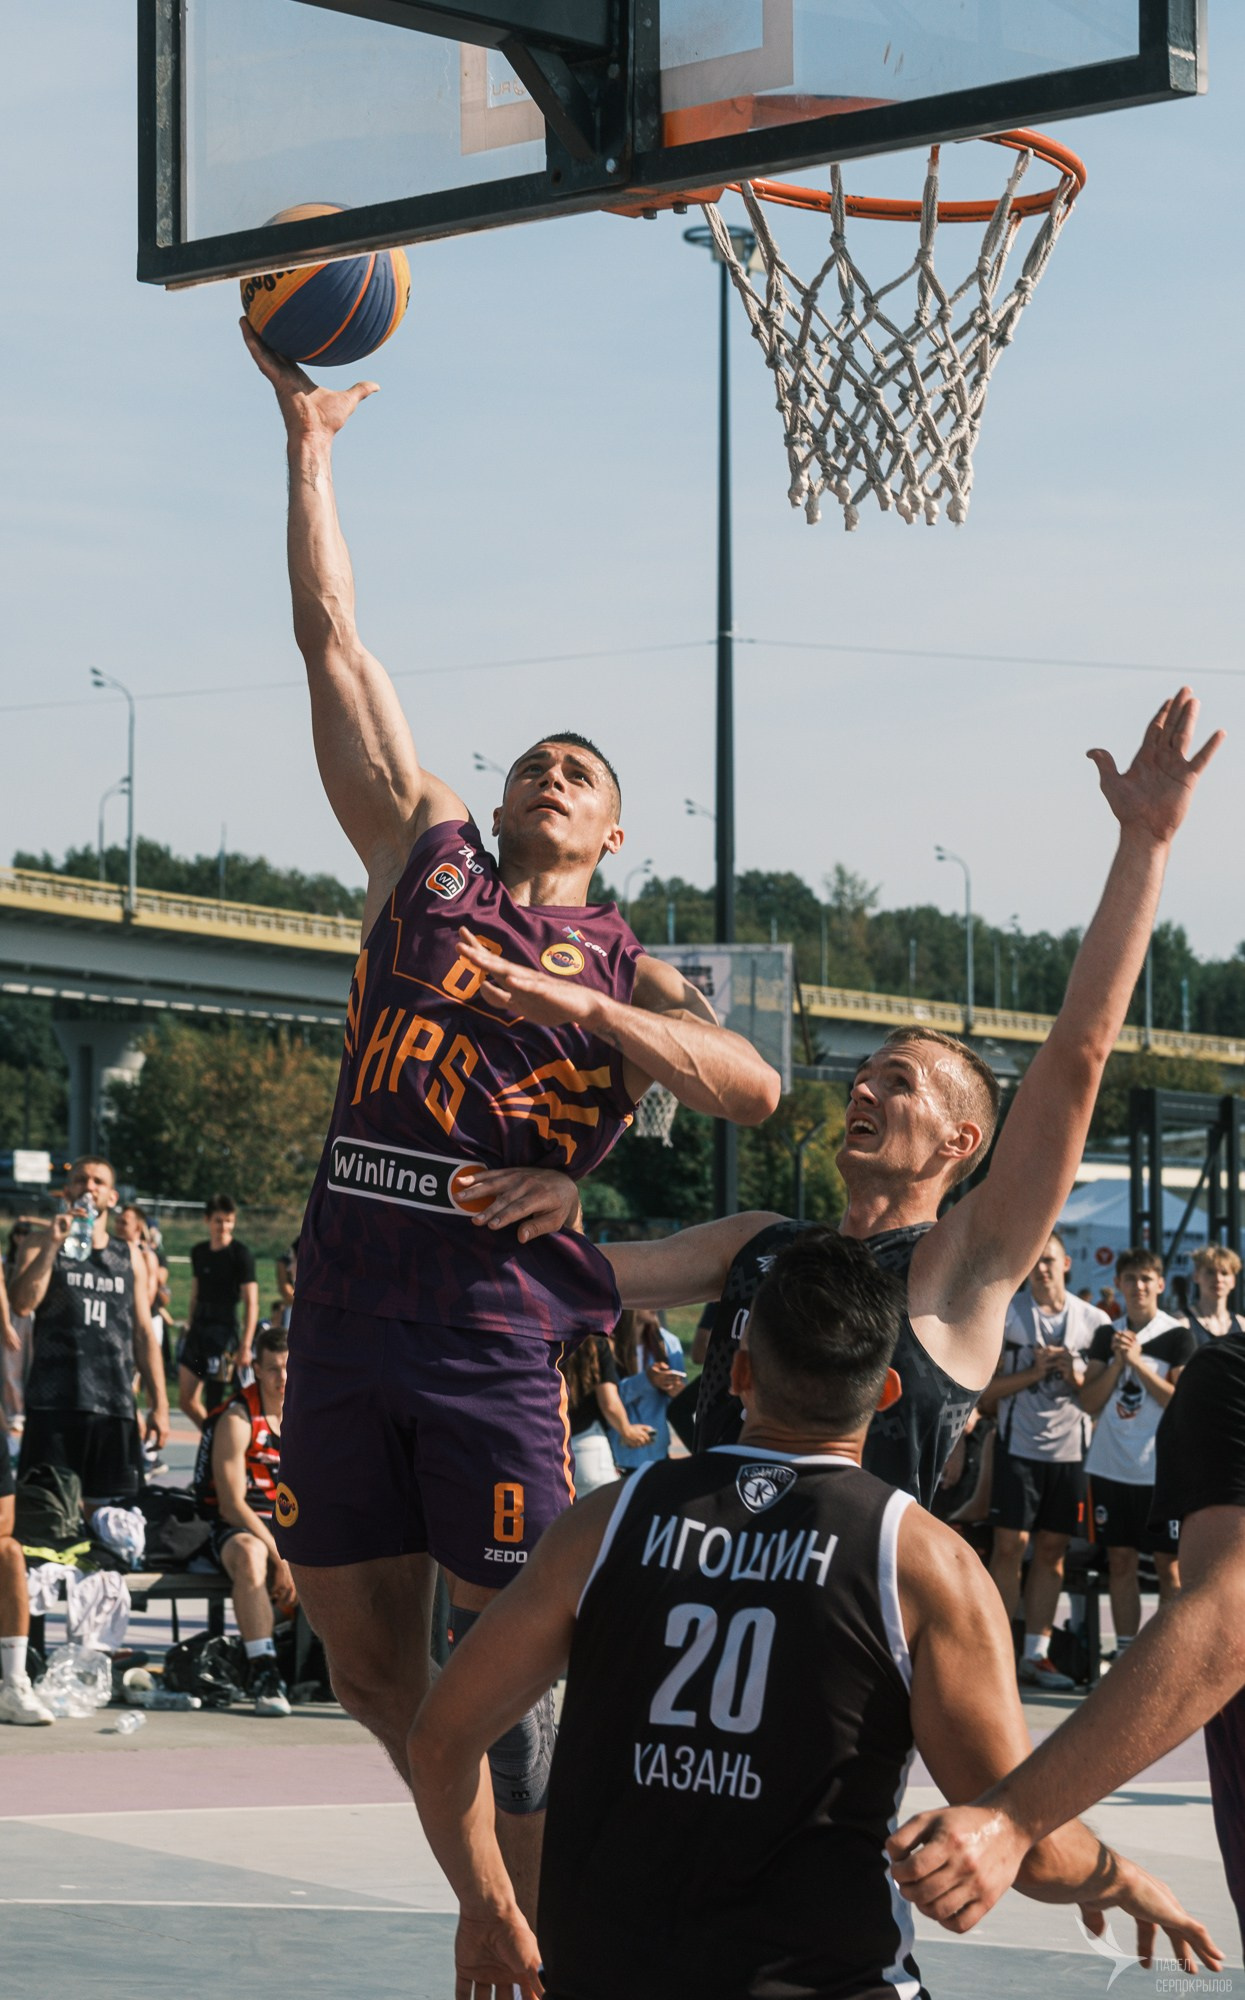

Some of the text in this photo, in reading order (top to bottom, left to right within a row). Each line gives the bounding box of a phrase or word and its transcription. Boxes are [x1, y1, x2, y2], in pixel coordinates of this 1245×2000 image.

[334, 1149, 438, 1197] Winline
[83, 1298, 107, 1329] 14
[494, 1483, 525, 1543] 8
[484, 1547, 528, 1563] ZEDO
[641, 1514, 839, 1587] ИГОШИН
[649, 1603, 777, 1734] 20
